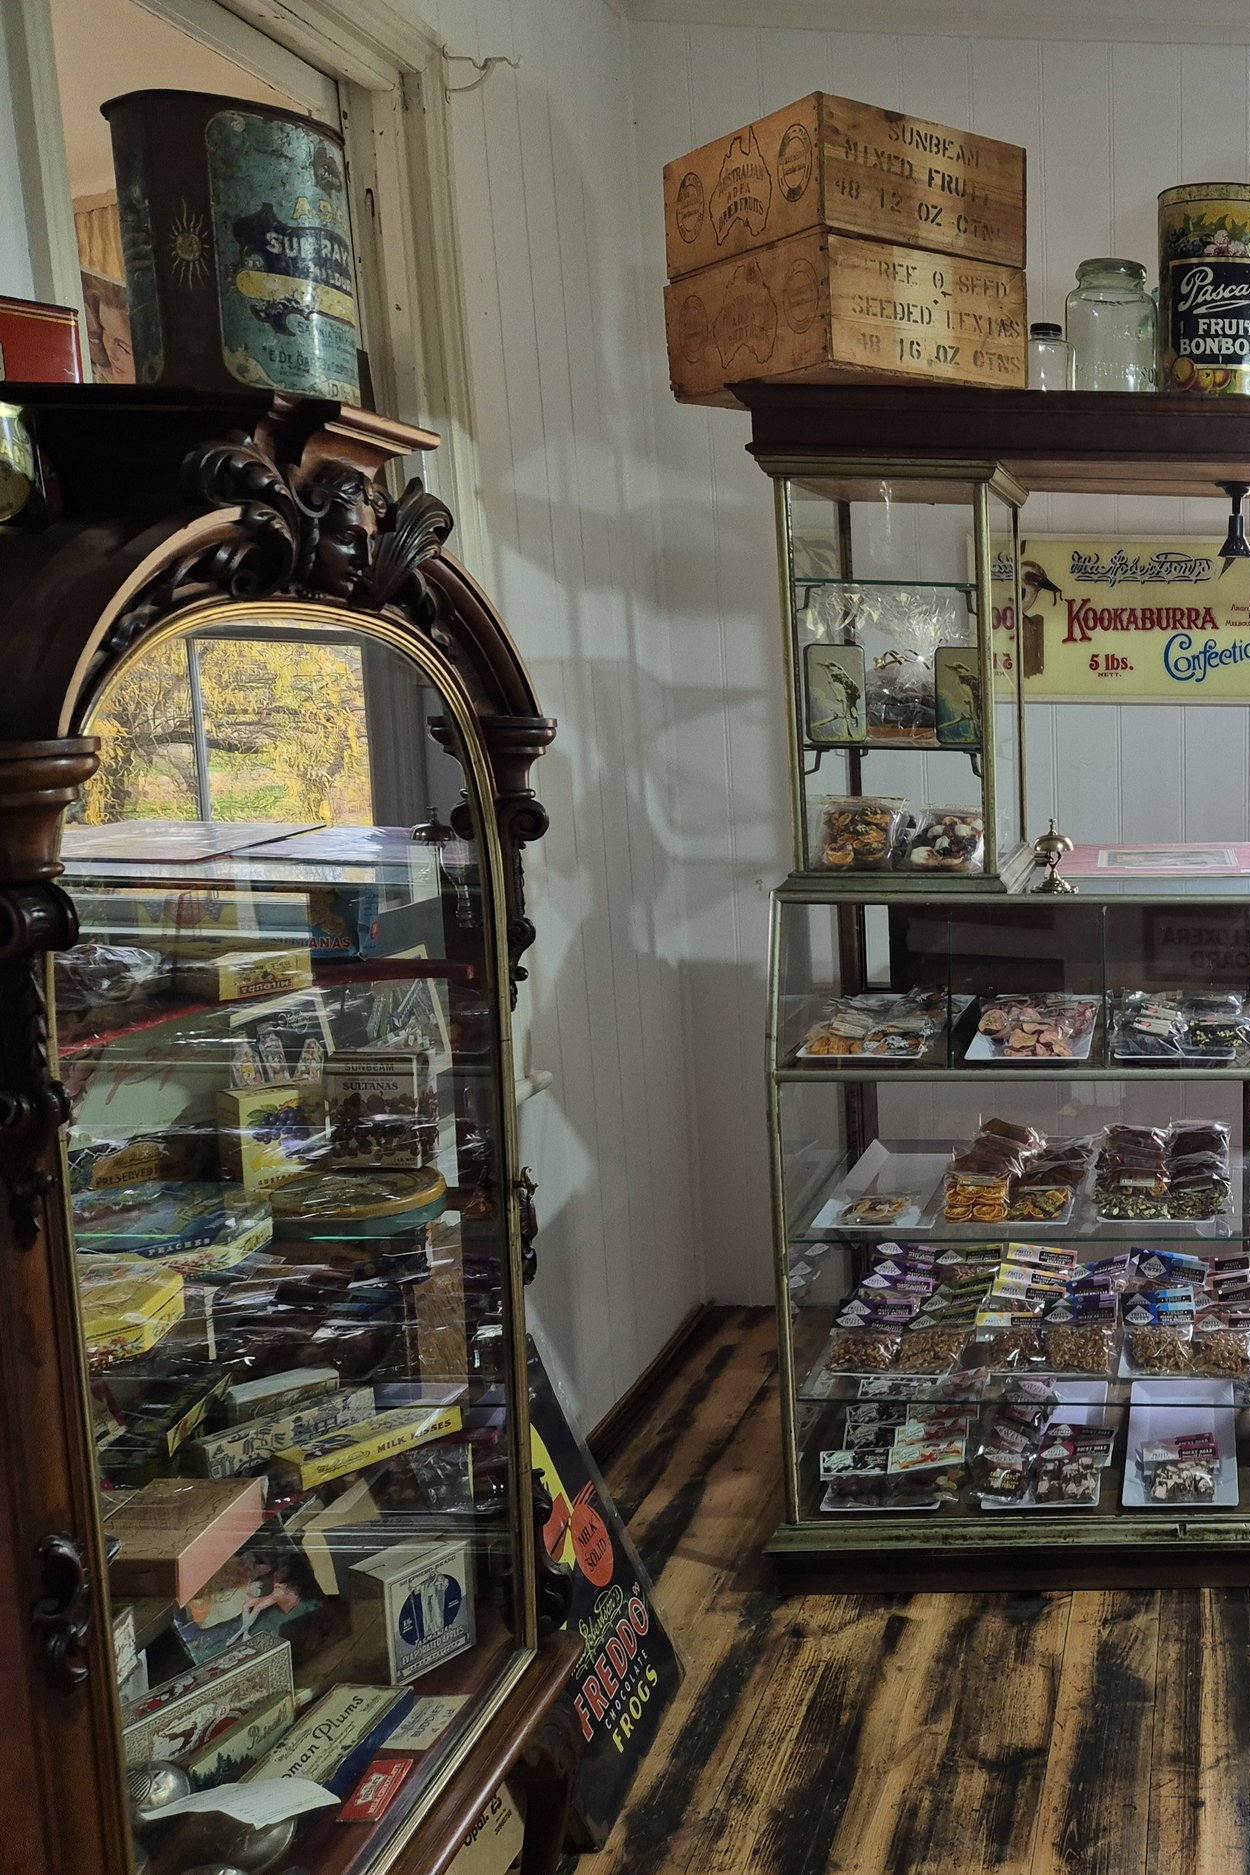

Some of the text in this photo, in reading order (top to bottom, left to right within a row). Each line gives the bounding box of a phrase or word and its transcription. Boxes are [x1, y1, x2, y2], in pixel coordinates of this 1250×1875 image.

[888, 121, 981, 169] SUNBEAM
[879, 188, 903, 213] 12
[917, 201, 943, 228] OZ
[958, 275, 1007, 300] SEED
[851, 295, 934, 326] SEEDED
[897, 337, 922, 360] 16
[1089, 653, 1100, 671] 5
[345, 1062, 394, 1072] SUNBEAM
[343, 1082, 398, 1091] SULTANAS
[377, 1436, 406, 1453] MILK
[577, 1517, 598, 1548] MILK
[586, 1537, 608, 1574] SOLID
[574, 1597, 649, 1743] FREDDO
[604, 1649, 648, 1730] CHOCOLATE
[612, 1664, 658, 1754] FROGS
[281, 1695, 364, 1779] oman Plums
